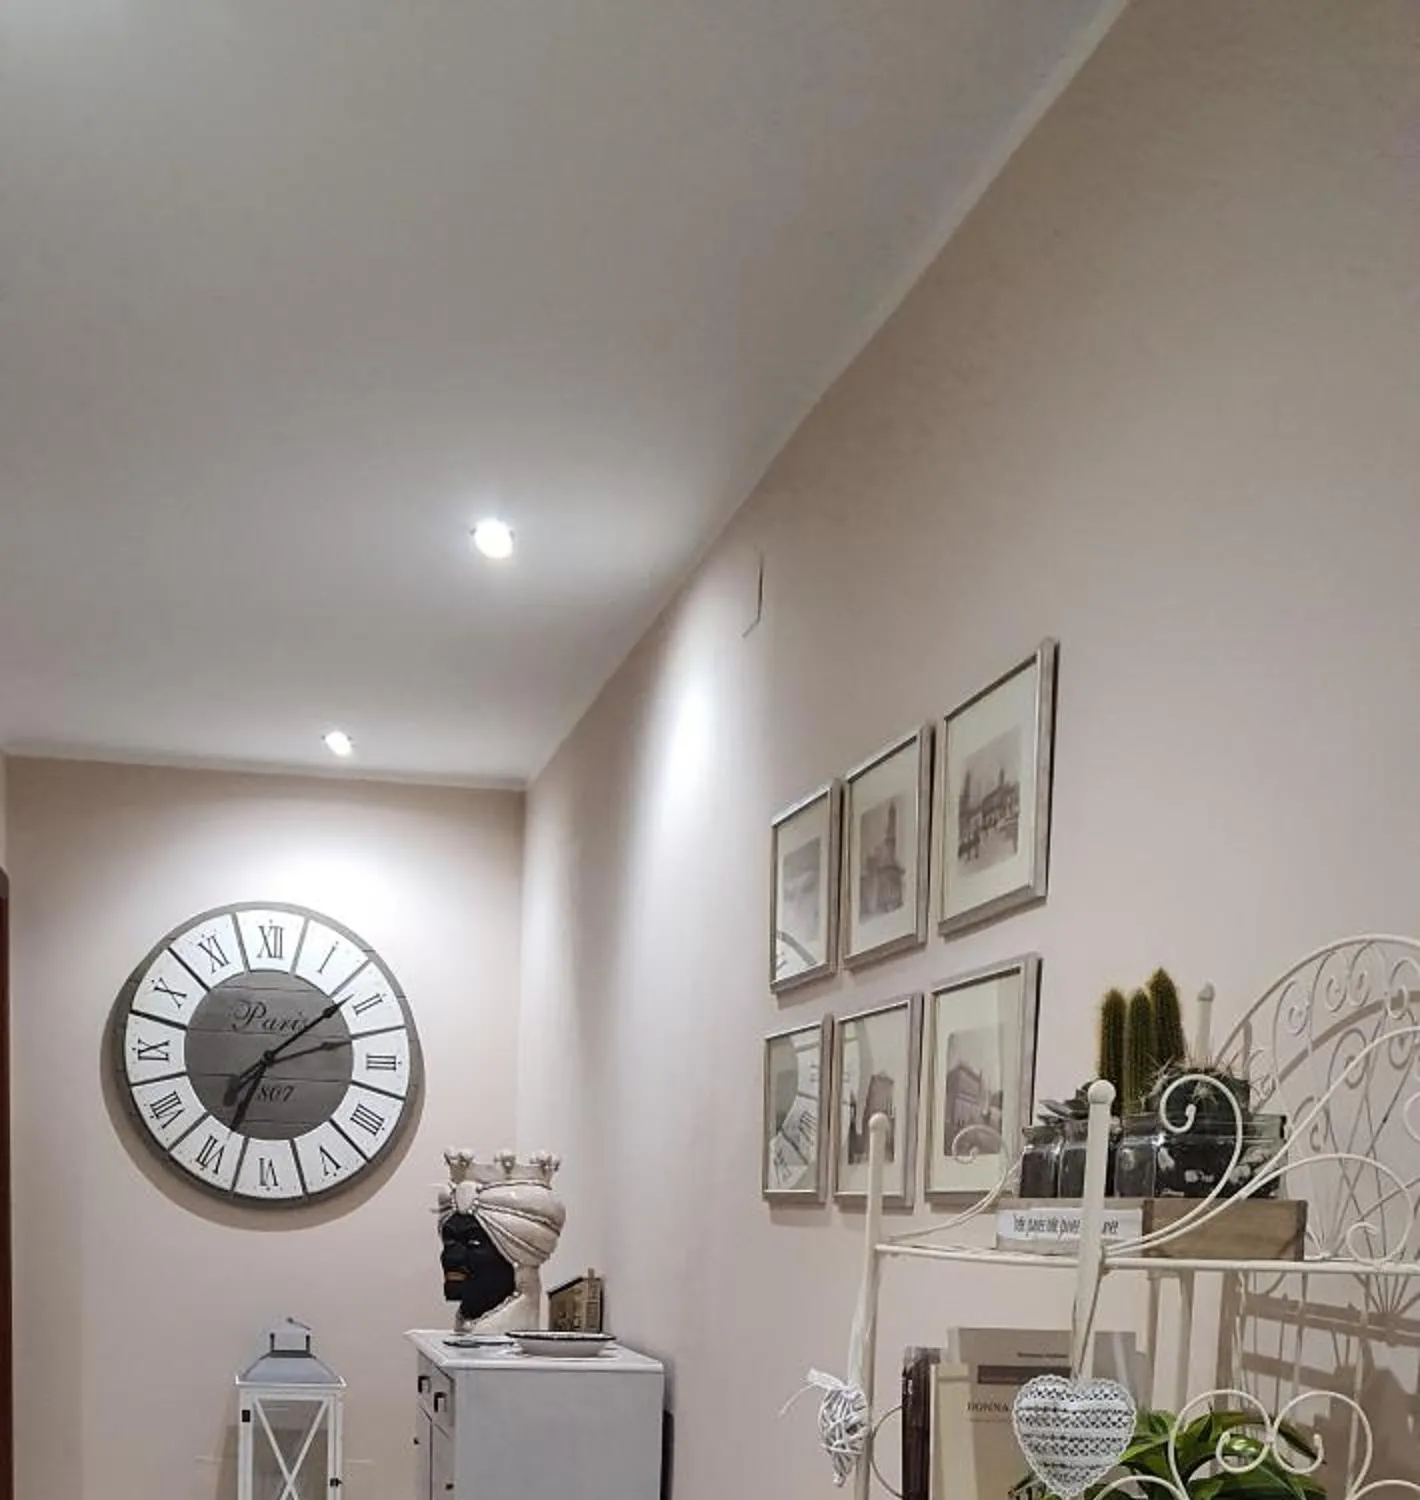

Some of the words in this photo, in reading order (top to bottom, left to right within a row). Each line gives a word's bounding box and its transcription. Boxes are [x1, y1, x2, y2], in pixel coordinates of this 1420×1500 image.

[197, 934, 231, 974] XI
[256, 924, 284, 960] XII
[153, 977, 188, 1010] X
[137, 1038, 171, 1062] IX
[366, 1053, 397, 1071] III
[256, 1083, 296, 1103] 807
[258, 1156, 280, 1188] VI
